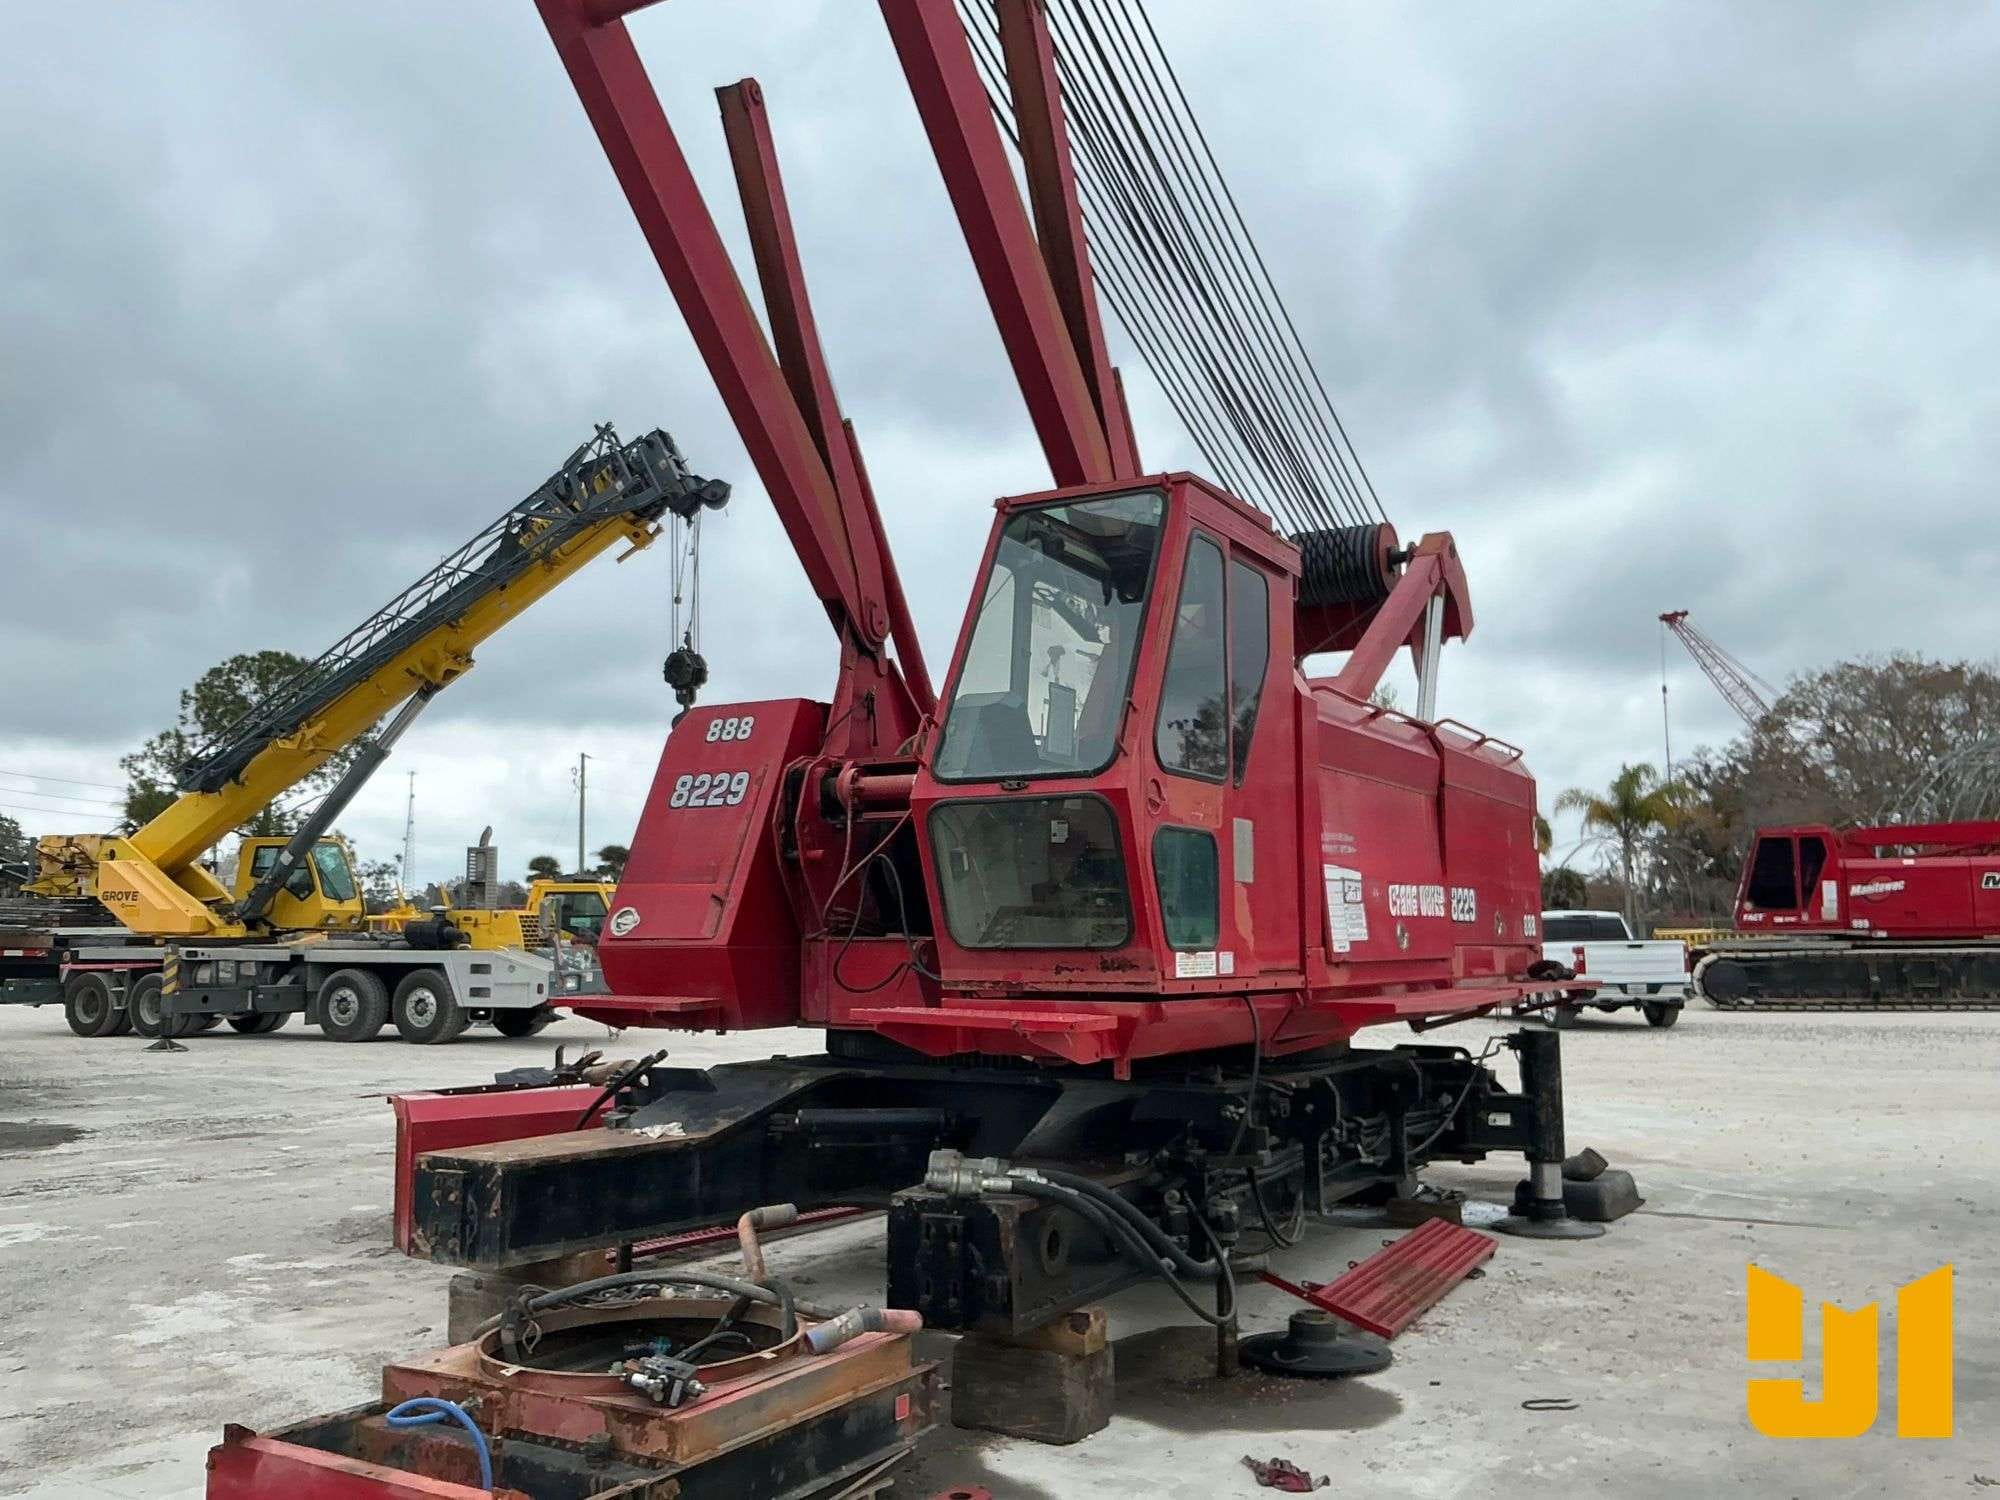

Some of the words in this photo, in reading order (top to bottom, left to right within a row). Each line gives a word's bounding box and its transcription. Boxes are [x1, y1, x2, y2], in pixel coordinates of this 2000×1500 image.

[705, 716, 755, 742] 888
[669, 771, 750, 808] 8229
[102, 890, 139, 901] GROVE
[1451, 887, 1476, 922] 8229
